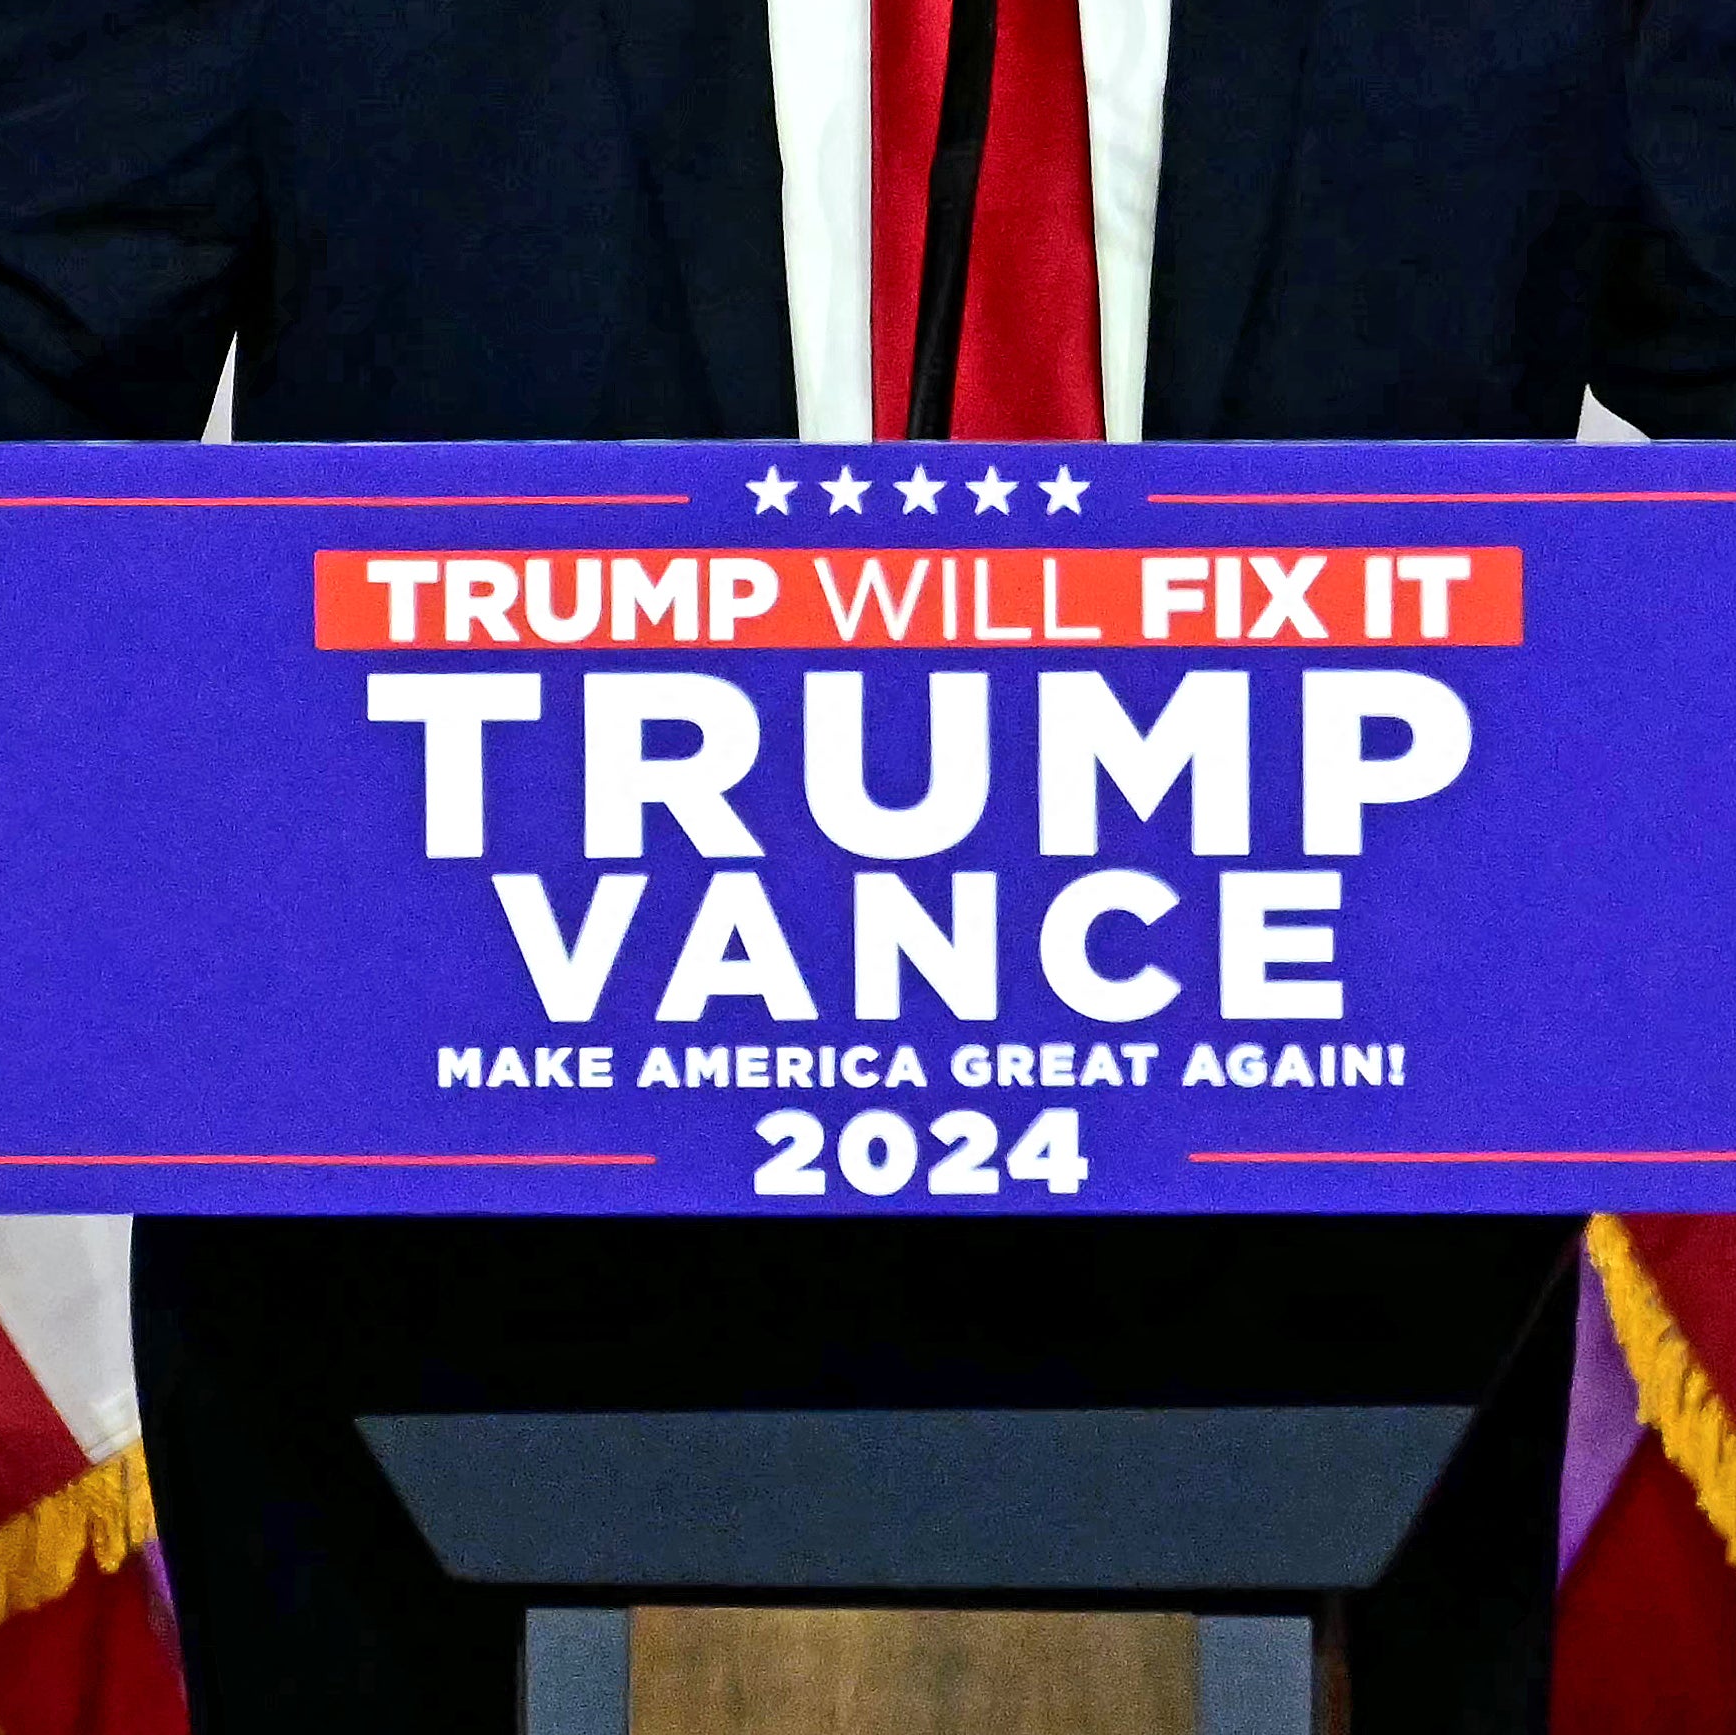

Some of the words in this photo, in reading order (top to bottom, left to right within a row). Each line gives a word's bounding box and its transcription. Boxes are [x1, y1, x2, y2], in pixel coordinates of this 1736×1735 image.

[367, 558, 779, 643] TRUMP
[814, 558, 1101, 641] WILL
[1142, 556, 1329, 639] FIX
[1365, 555, 1471, 638] IT
[367, 670, 1472, 859] TRUMP
[492, 869, 1343, 1022] VANCE
[438, 1047, 613, 1087] MAKE
[637, 1046, 927, 1088] AMERICA
[951, 1043, 1159, 1087] GREAT
[1183, 1043, 1405, 1087] AGAIN!
[754, 1108, 1088, 1196] 2024
